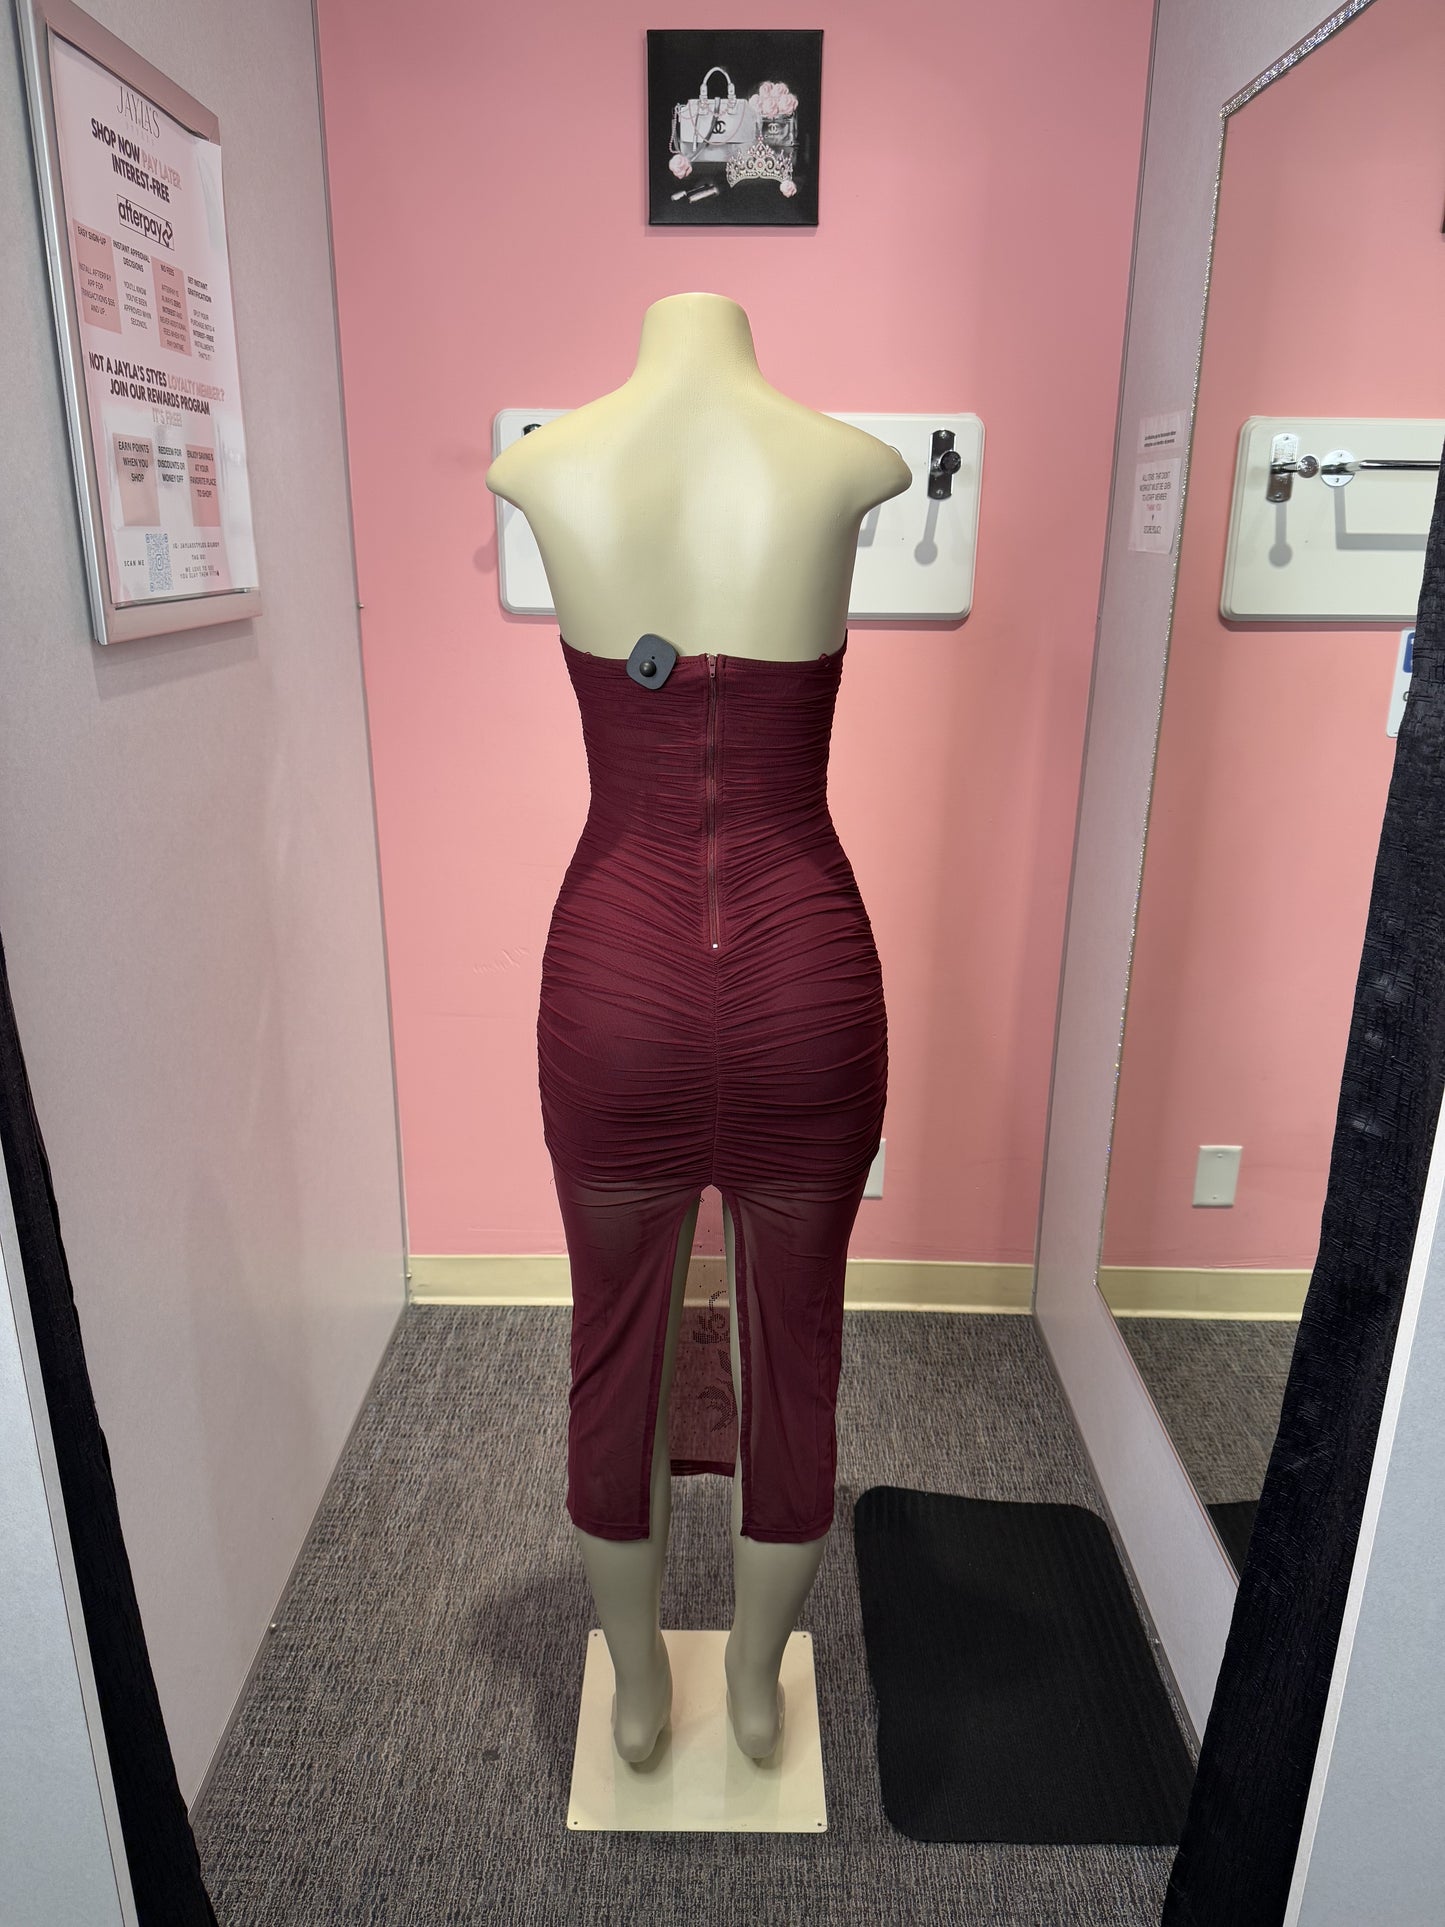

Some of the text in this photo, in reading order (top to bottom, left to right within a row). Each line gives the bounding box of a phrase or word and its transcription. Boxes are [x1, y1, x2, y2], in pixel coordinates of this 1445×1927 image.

[91, 118, 116, 149] SHOP
[118, 135, 140, 164] NOW
[141, 148, 158, 175] PAY
[112, 153, 170, 203] INTEREST-FREE
[118, 200, 162, 244] afterpay
[89, 352, 104, 373] NOT
[106, 359, 114, 374] A
[114, 361, 145, 382] JAYLA'S
[146, 368, 167, 387] STYES
[110, 378, 210, 416] JOIN OUR REWARDS PROGRAM
[118, 441, 149, 454] EARN POINTS
[123, 457, 149, 469] WHEN YOU
[131, 473, 145, 483] SHOP
